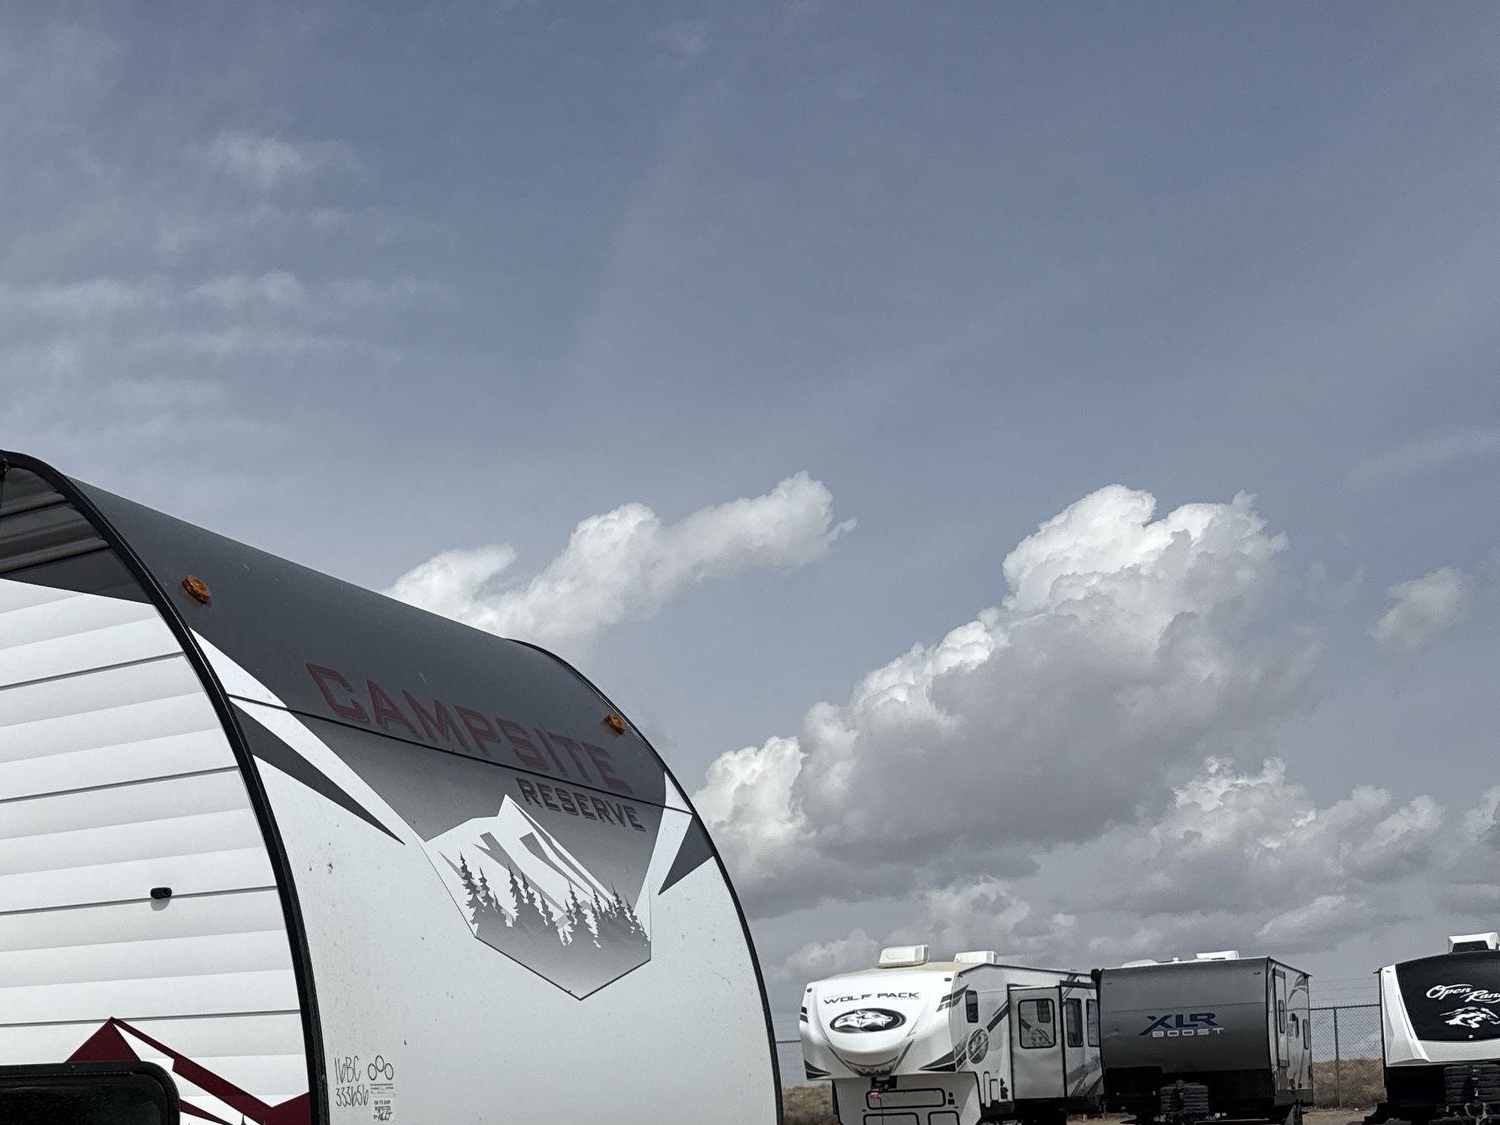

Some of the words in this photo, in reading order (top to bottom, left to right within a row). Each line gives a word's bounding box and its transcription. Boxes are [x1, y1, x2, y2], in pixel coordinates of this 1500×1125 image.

[308, 663, 631, 791] CAMPSITE
[516, 777, 646, 831] RESERVE
[825, 993, 872, 1004] WOLF
[1426, 984, 1474, 1000] Open
[1460, 990, 1500, 1003] Ran
[1139, 1013, 1219, 1036] XLR
[1152, 1027, 1225, 1037] BOOST
